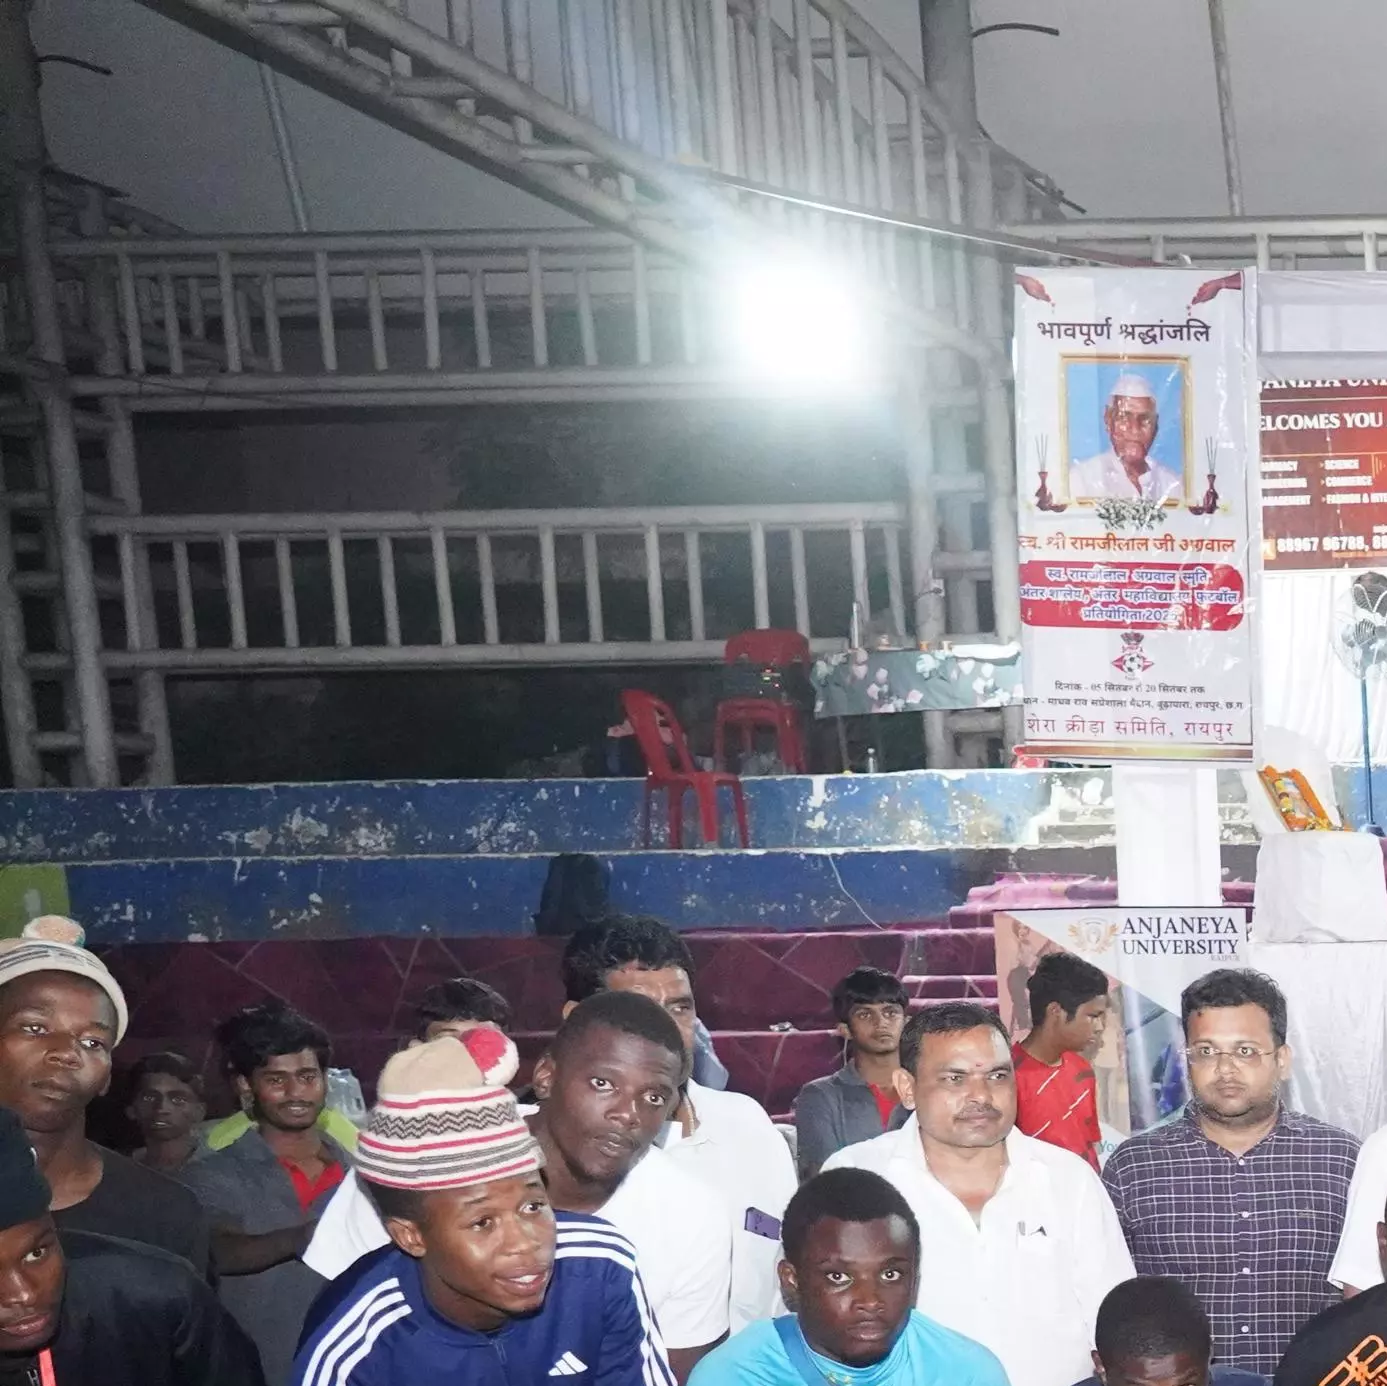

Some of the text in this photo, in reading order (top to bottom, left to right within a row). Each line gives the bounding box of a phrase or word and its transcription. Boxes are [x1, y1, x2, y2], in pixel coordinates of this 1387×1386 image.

[1036, 316, 1212, 346] भावपूर्ण श्रद्धांजलि
[1259, 413, 1341, 432] ELCOMES
[1342, 412, 1384, 430] YOU
[1069, 533, 1149, 553] रामजीलाल
[1152, 533, 1175, 553] जी
[1026, 713, 1056, 734] शेरा
[1183, 721, 1234, 741] रायपुर
[1120, 916, 1239, 940] ANJANEYA
[1121, 939, 1240, 956] UNIVERSITY
